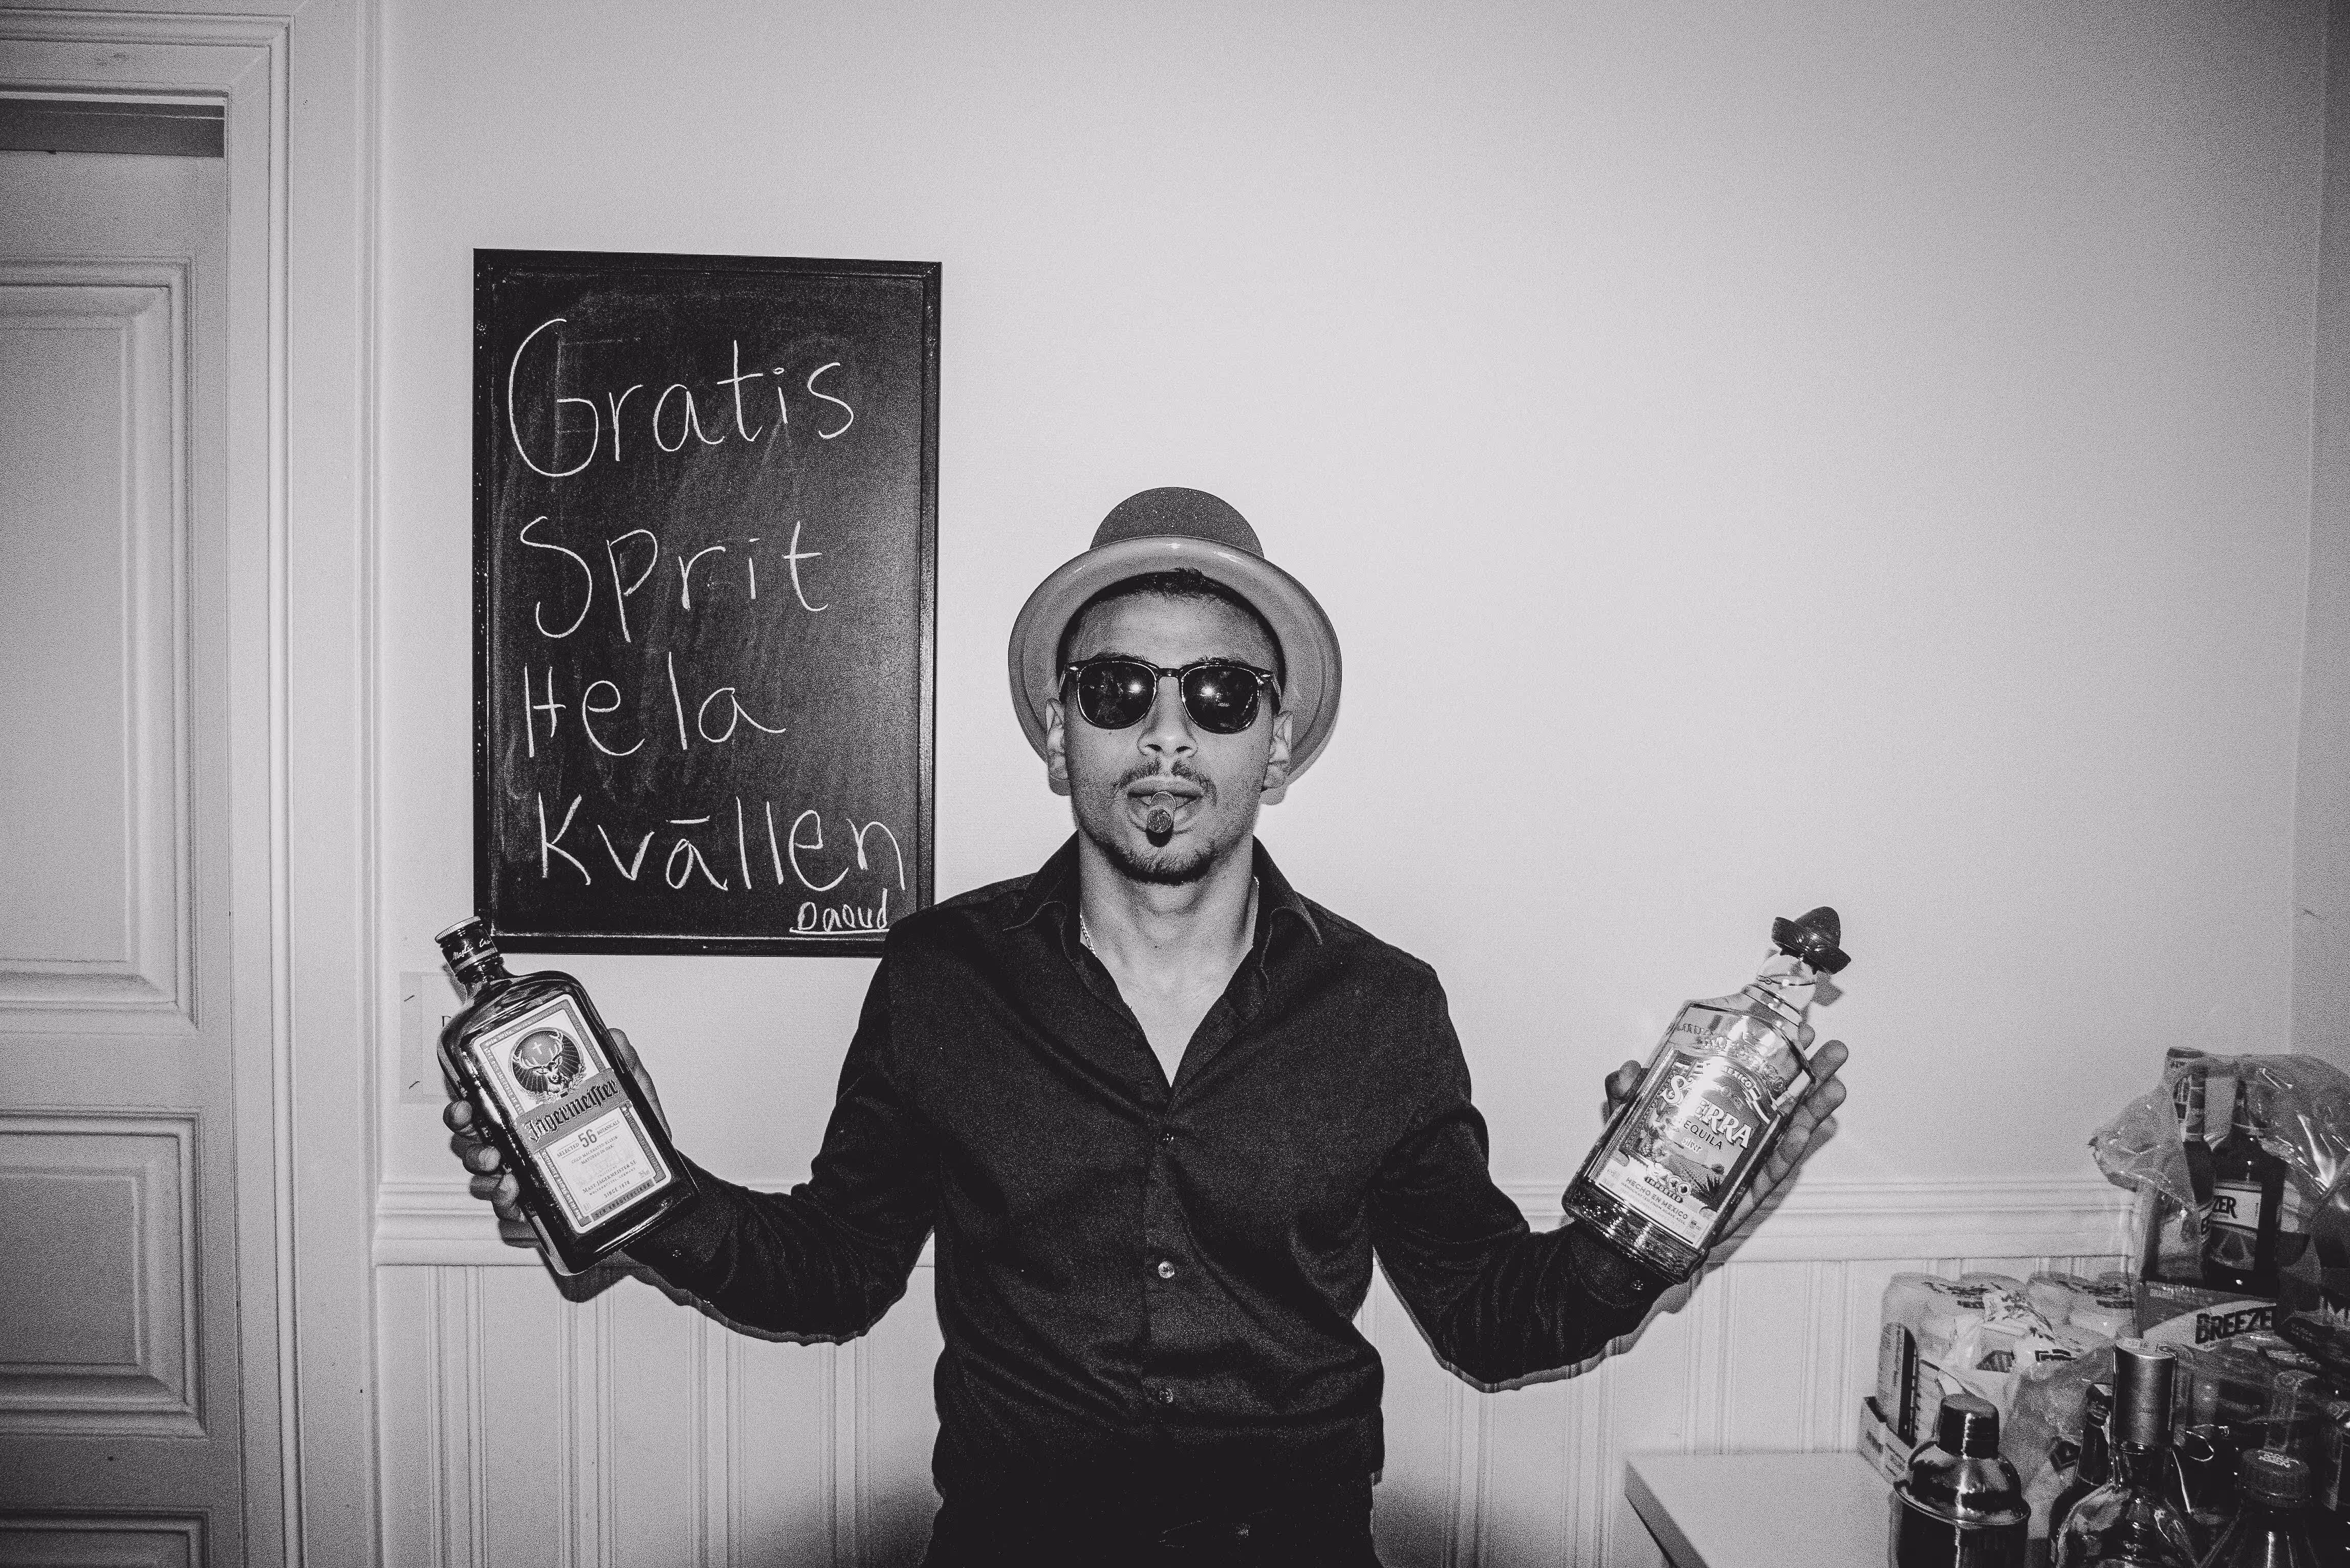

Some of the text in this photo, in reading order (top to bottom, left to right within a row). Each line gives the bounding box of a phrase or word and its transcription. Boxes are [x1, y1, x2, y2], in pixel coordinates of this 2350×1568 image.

[507, 318, 854, 476] Gratis
[523, 651, 787, 759] Hela
[1661, 1074, 1755, 1149] SERRA
[556, 1119, 620, 1158] SELECTED 56 BOTANICALS
[1678, 1118, 1723, 1150] EQUILA
[1624, 1177, 1652, 1197] HECHO
[1650, 1192, 1662, 1203] EN
[1660, 1199, 1689, 1220] MEXICO
[1644, 1177, 1682, 1202] IMPORTED
